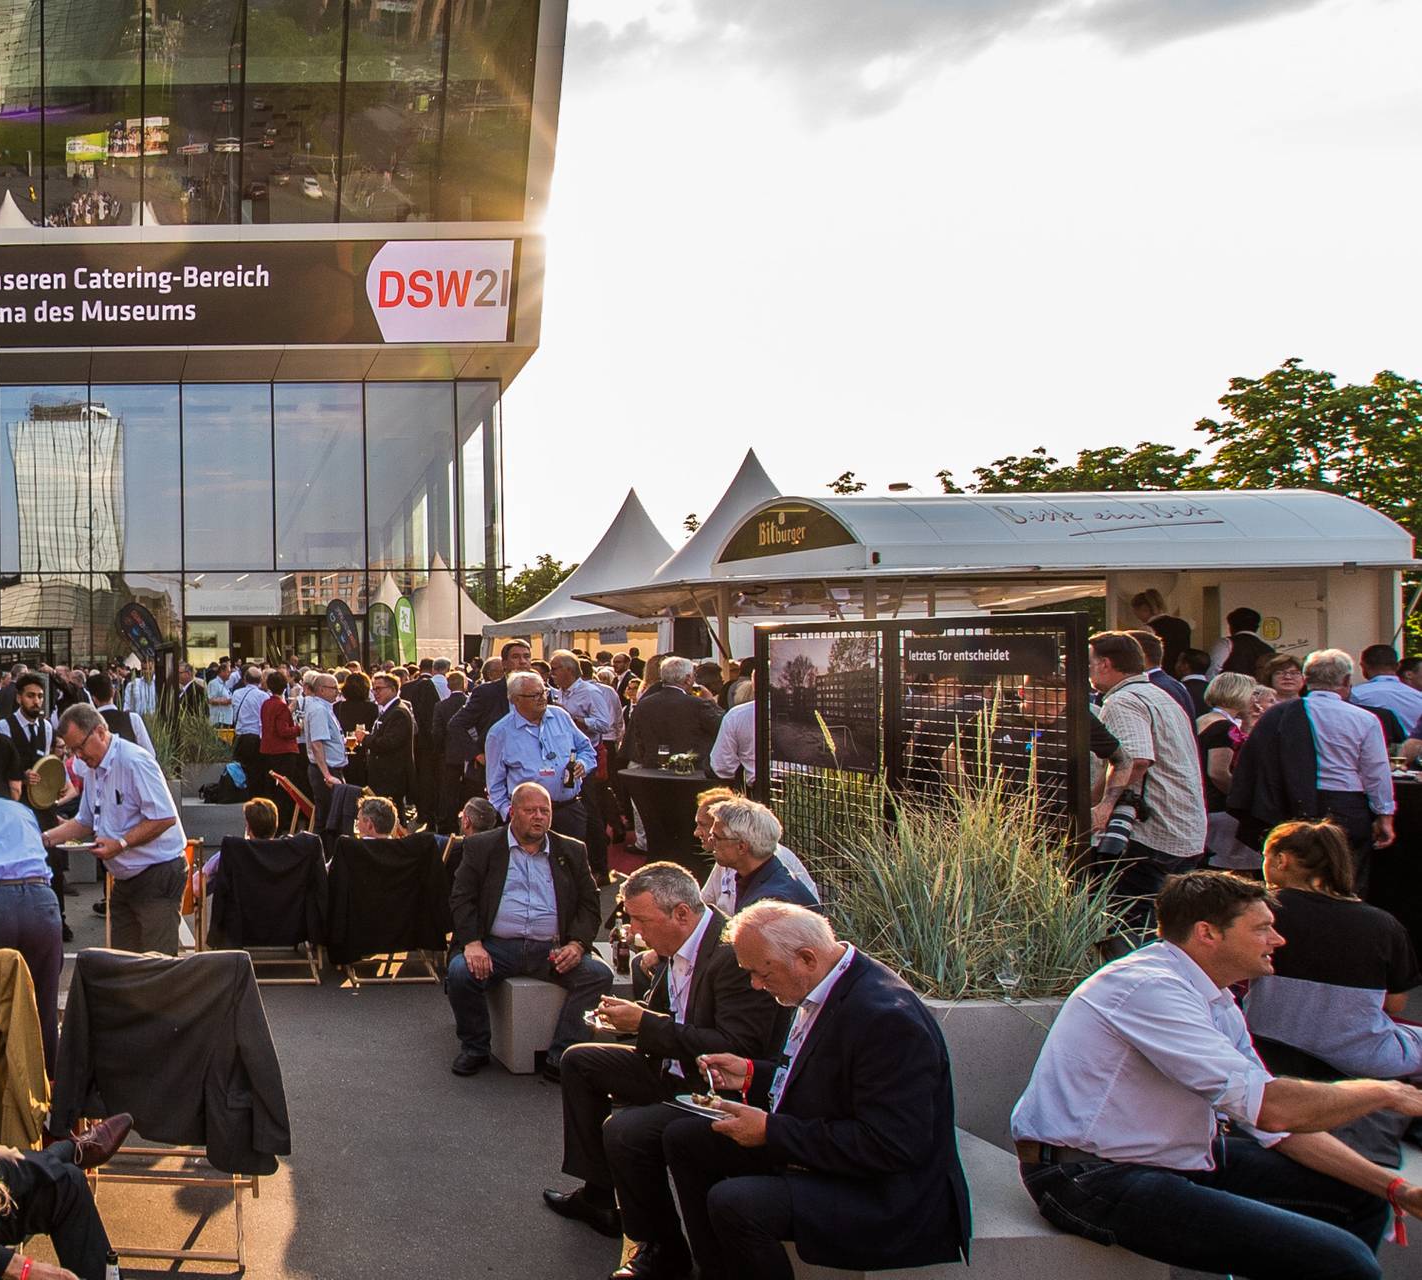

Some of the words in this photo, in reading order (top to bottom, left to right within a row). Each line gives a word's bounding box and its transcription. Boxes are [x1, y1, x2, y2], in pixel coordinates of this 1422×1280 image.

[73, 264, 270, 294] Catering-Bereich
[34, 300, 75, 323] des
[81, 300, 197, 322] Museums
[758, 521, 807, 546] Bitburger
[908, 650, 937, 661] letztes
[937, 650, 952, 661] Tor
[953, 649, 1010, 661] entscheidet
